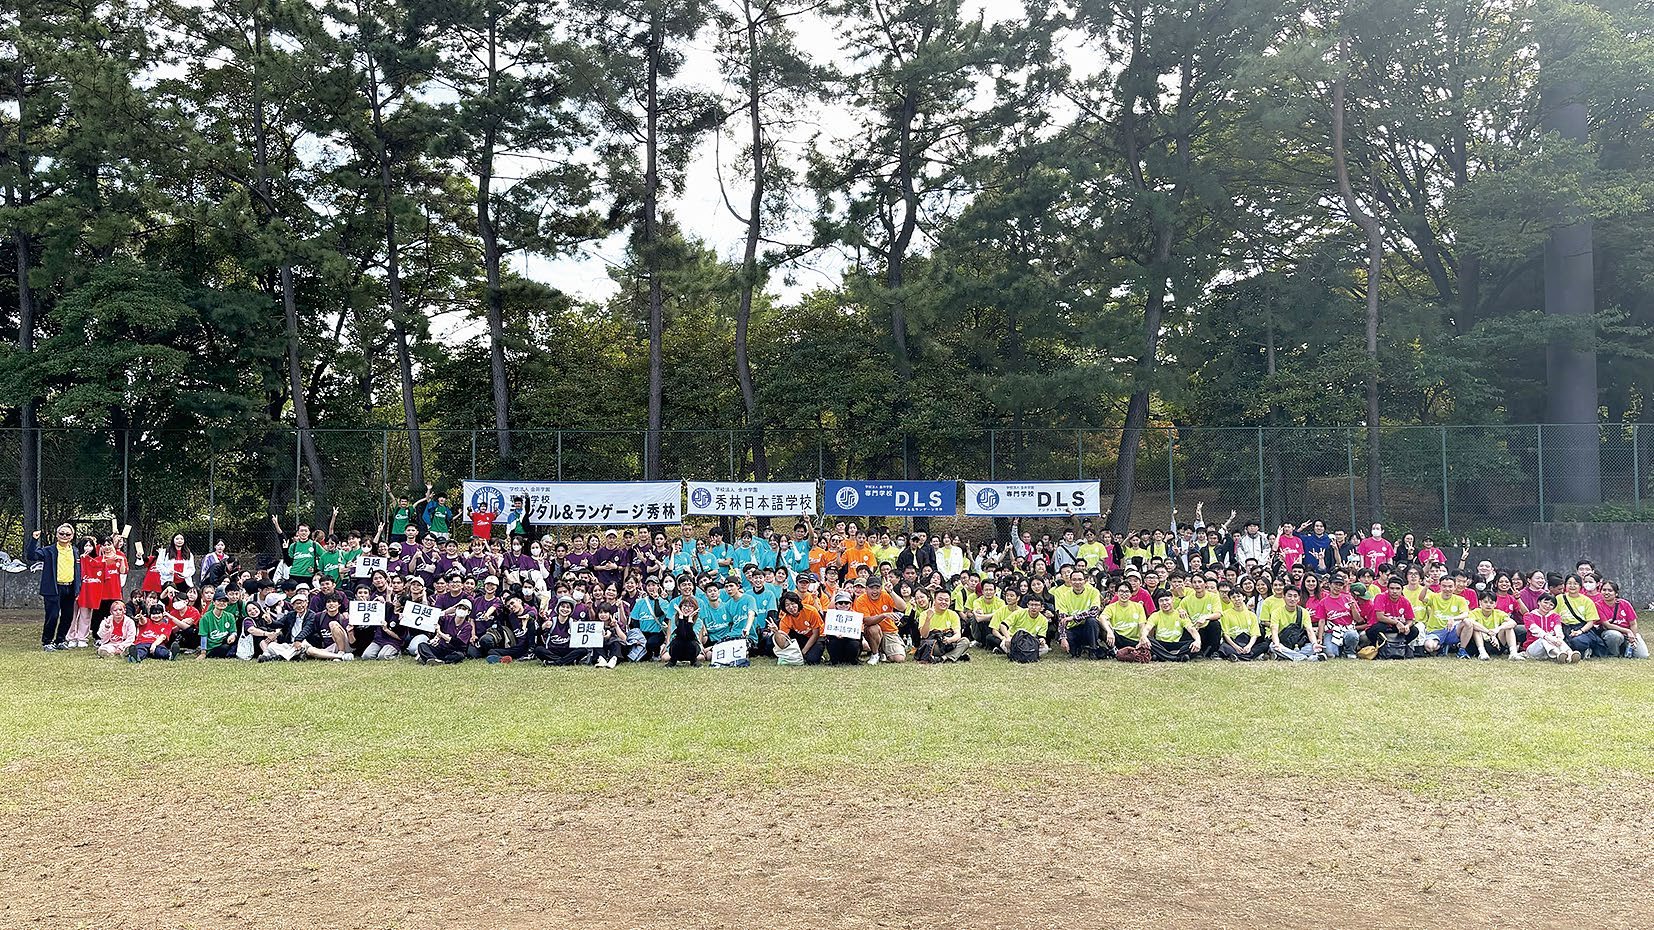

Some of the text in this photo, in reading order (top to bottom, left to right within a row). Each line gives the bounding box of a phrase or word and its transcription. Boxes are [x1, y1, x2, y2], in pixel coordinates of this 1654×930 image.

[715, 494, 812, 511] 秀林日本語学校
[895, 491, 942, 507] DLS
[1038, 491, 1085, 507] DLS
[510, 503, 676, 520] ジタル&ランゲージ秀林
[363, 613, 371, 622] B
[414, 616, 424, 626] C
[581, 634, 589, 645] D
